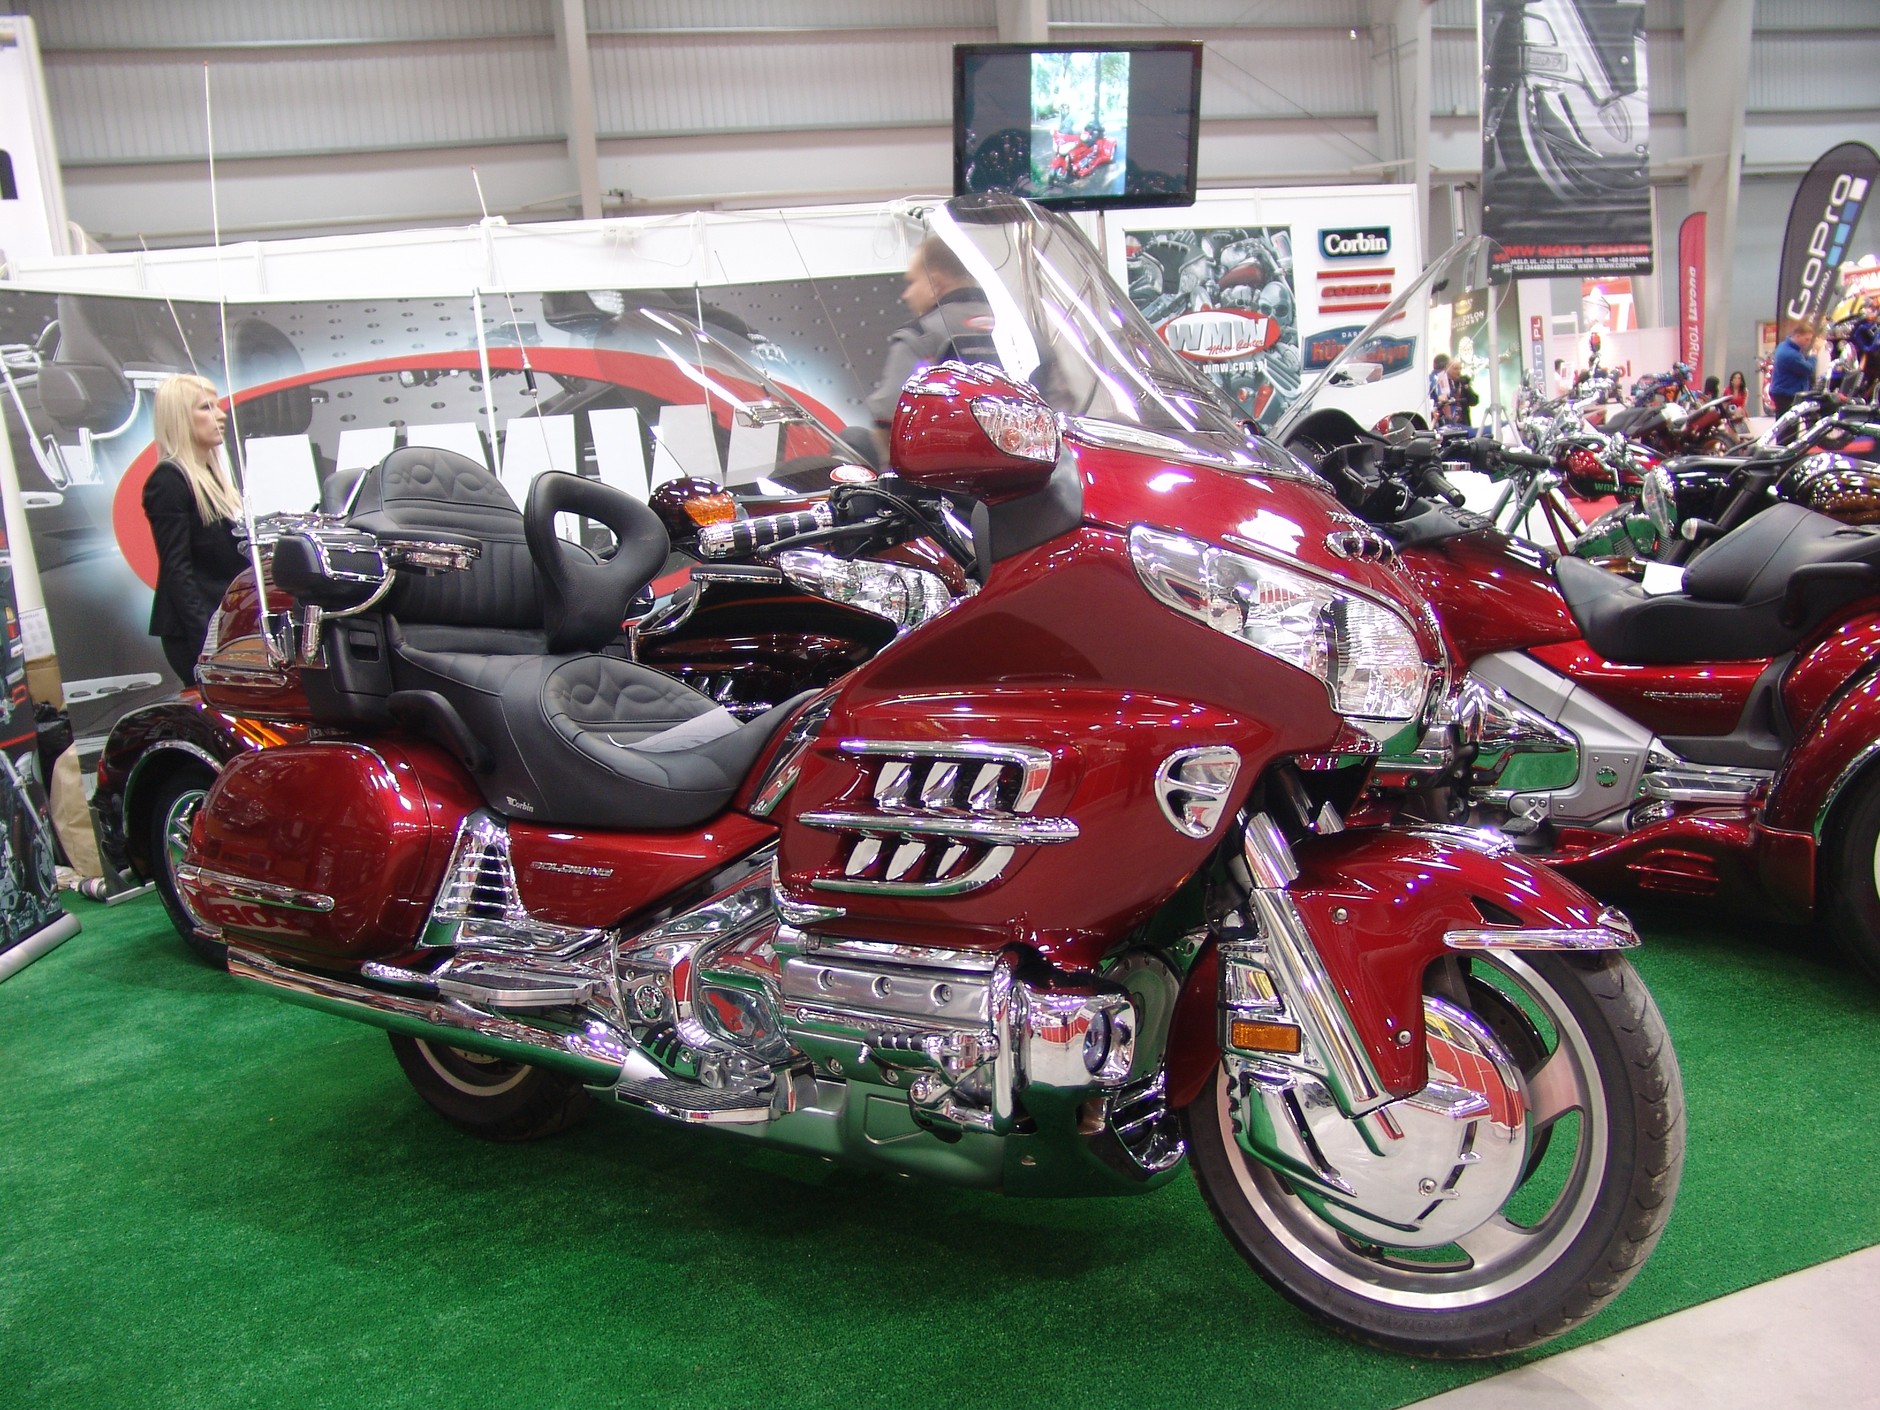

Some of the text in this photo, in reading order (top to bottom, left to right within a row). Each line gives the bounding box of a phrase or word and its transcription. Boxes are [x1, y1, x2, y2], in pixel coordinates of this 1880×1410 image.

[1325, 232, 1388, 254] Corbin
[1321, 283, 1392, 297] COBRA
[1688, 265, 1698, 321] DUCATI
[1167, 318, 1269, 351] WMW
[1534, 319, 1542, 338] PL
[511, 799, 534, 813] Corbin
